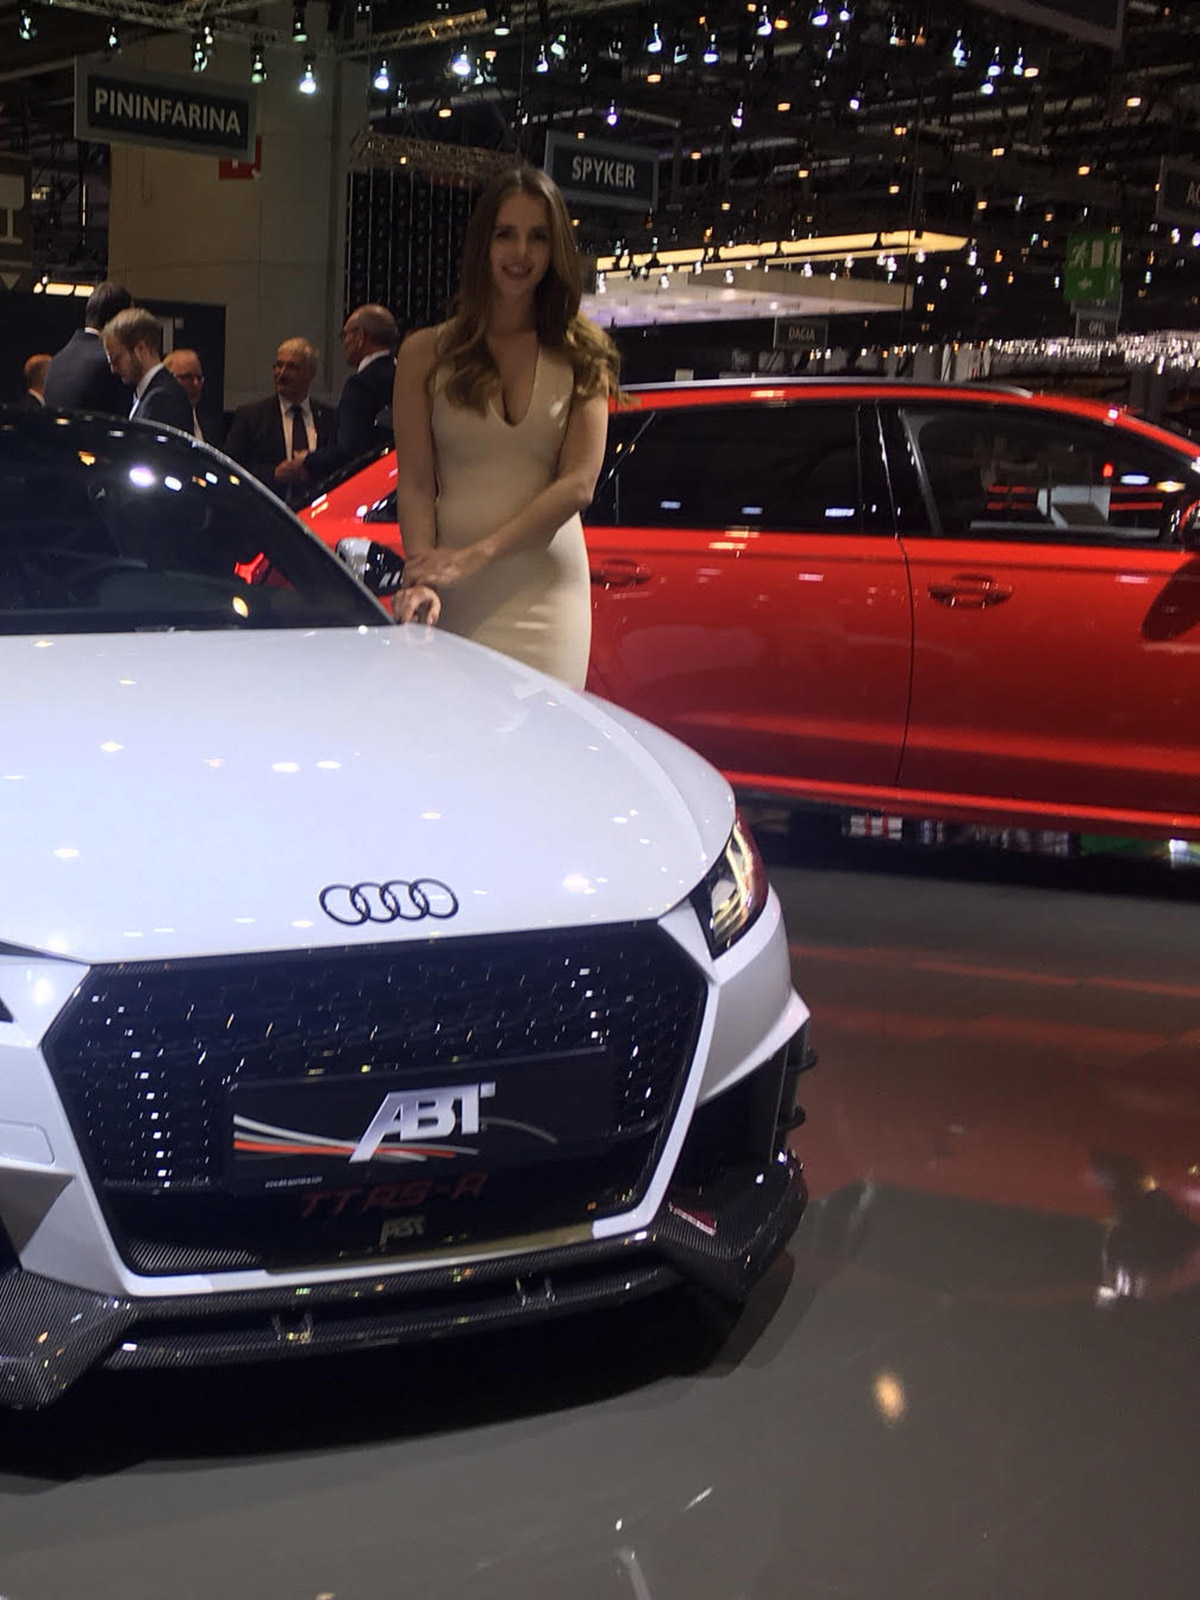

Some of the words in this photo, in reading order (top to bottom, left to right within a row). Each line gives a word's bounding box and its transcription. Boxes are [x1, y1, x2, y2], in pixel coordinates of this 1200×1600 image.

[94, 87, 241, 136] PININFARINA
[572, 155, 635, 189] SPYKER
[349, 1082, 496, 1163] ABT
